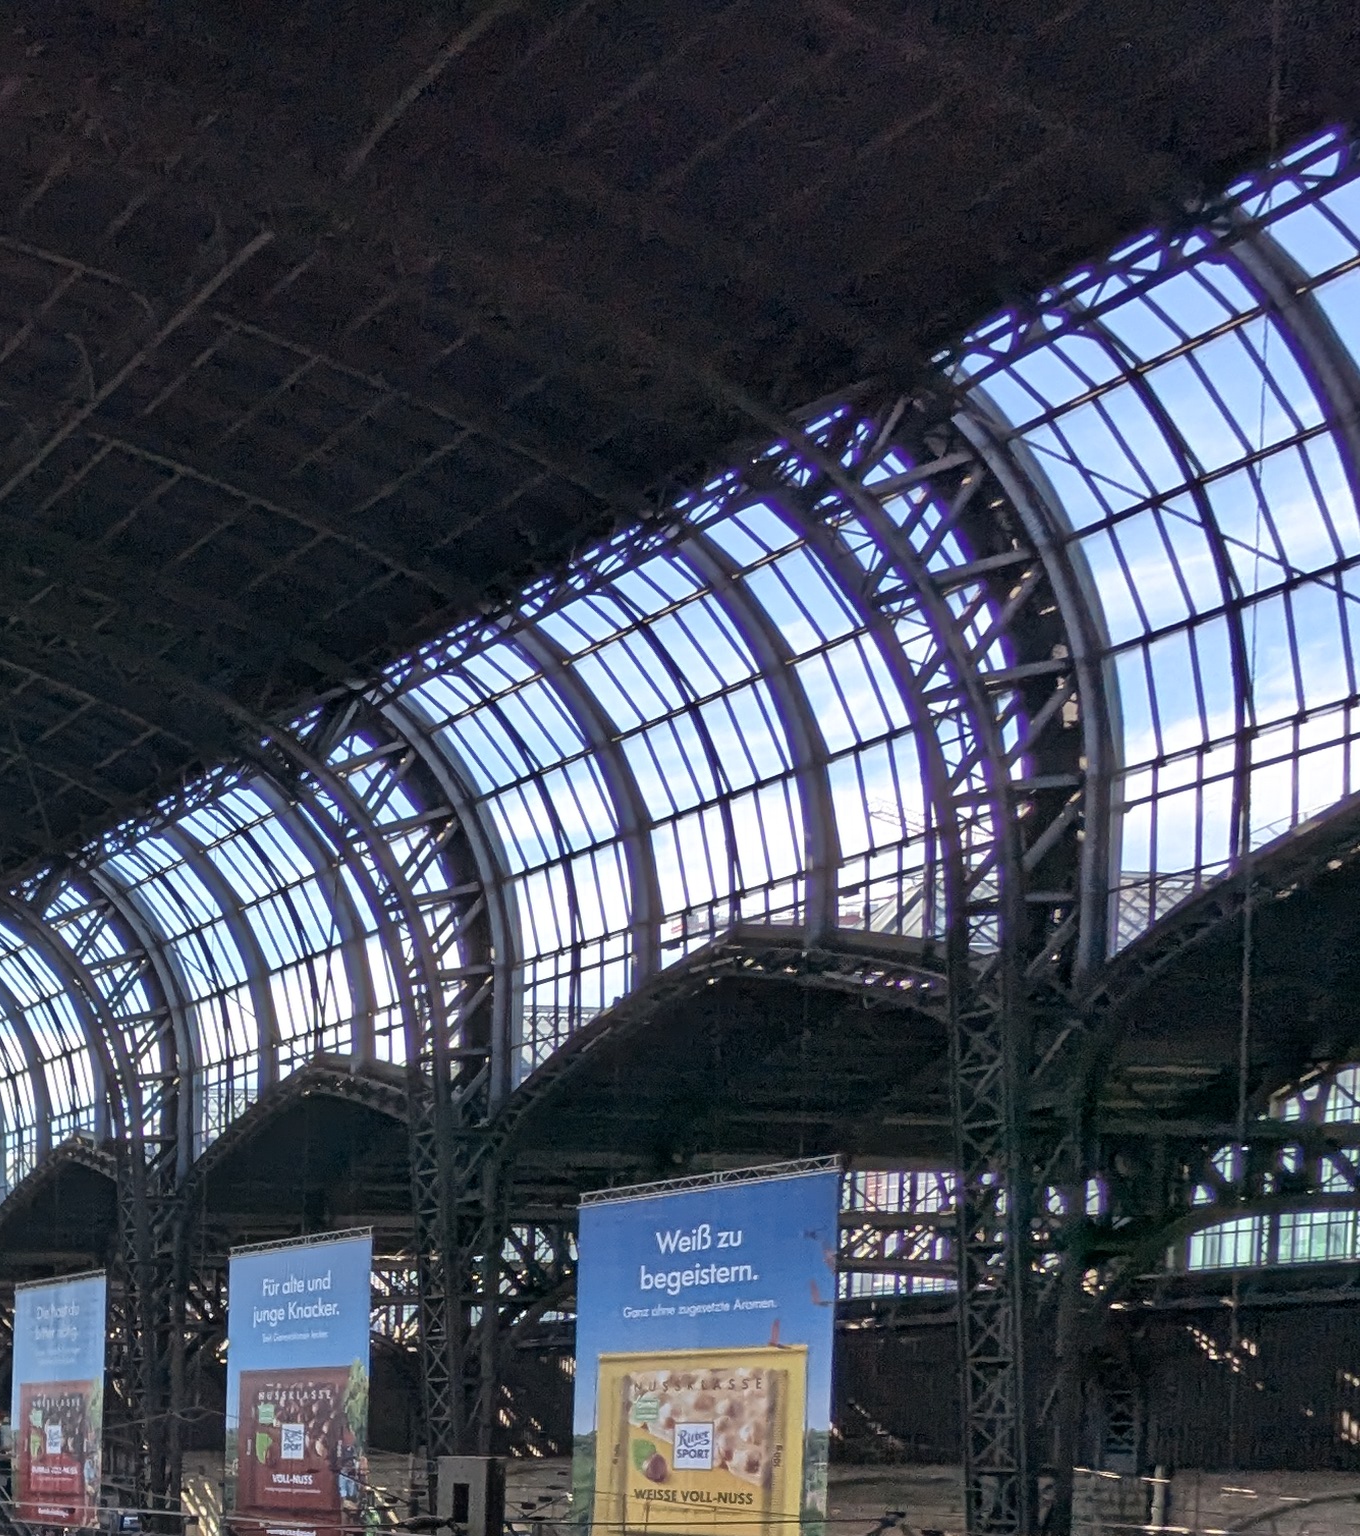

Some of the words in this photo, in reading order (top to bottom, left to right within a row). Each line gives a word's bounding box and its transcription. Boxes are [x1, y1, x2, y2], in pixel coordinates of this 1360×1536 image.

[656, 1223, 711, 1254] Weiß
[717, 1230, 742, 1248] zu
[262, 1278, 279, 1297] Für
[282, 1275, 304, 1294] alte
[307, 1270, 331, 1291] und
[640, 1263, 759, 1296] begeistern.
[253, 1306, 284, 1328] junge
[288, 1298, 340, 1320] Knacker.
[623, 1307, 649, 1319] Ganz
[634, 1378, 762, 1393] NUSSKLASSE
[258, 1390, 331, 1400] NUSSKLASSE
[677, 1449, 709, 1459] SPORT
[272, 1474, 313, 1484] VOLL-NUSS
[634, 1488, 677, 1501] WEISSE
[680, 1491, 753, 1505] VOLL-NUSS
